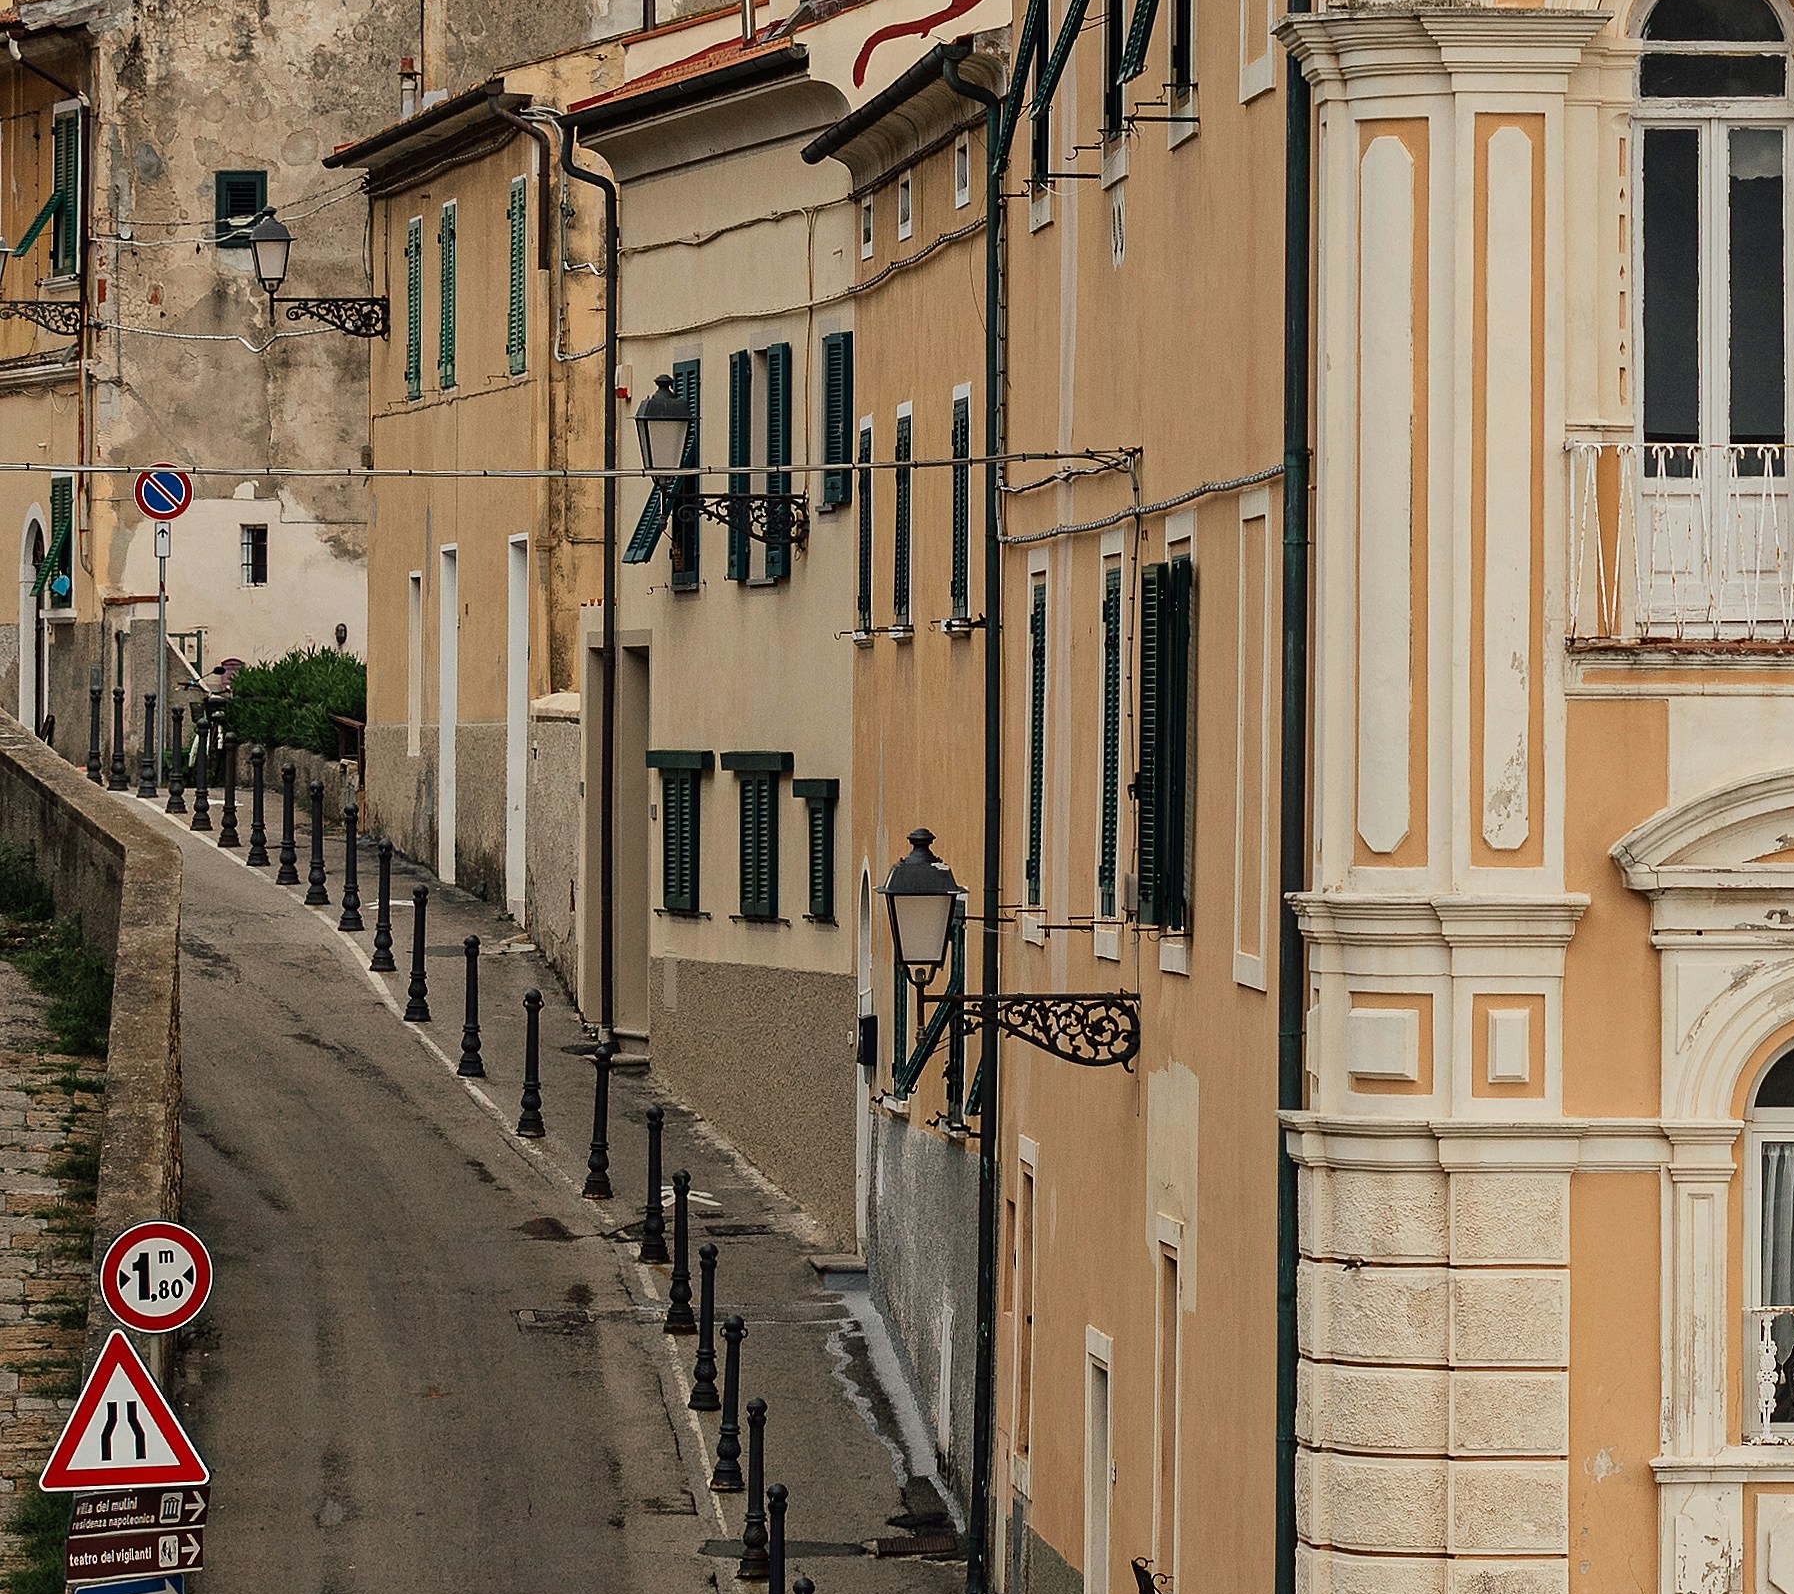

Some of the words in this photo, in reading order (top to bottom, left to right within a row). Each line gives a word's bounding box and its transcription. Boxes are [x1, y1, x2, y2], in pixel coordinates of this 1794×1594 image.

[158, 1249, 175, 1264] m
[72, 1518, 107, 1531] residenza
[108, 1513, 155, 1528] napoleonica
[69, 1552, 98, 1567] teatro
[116, 1546, 152, 1564] vigilanti
